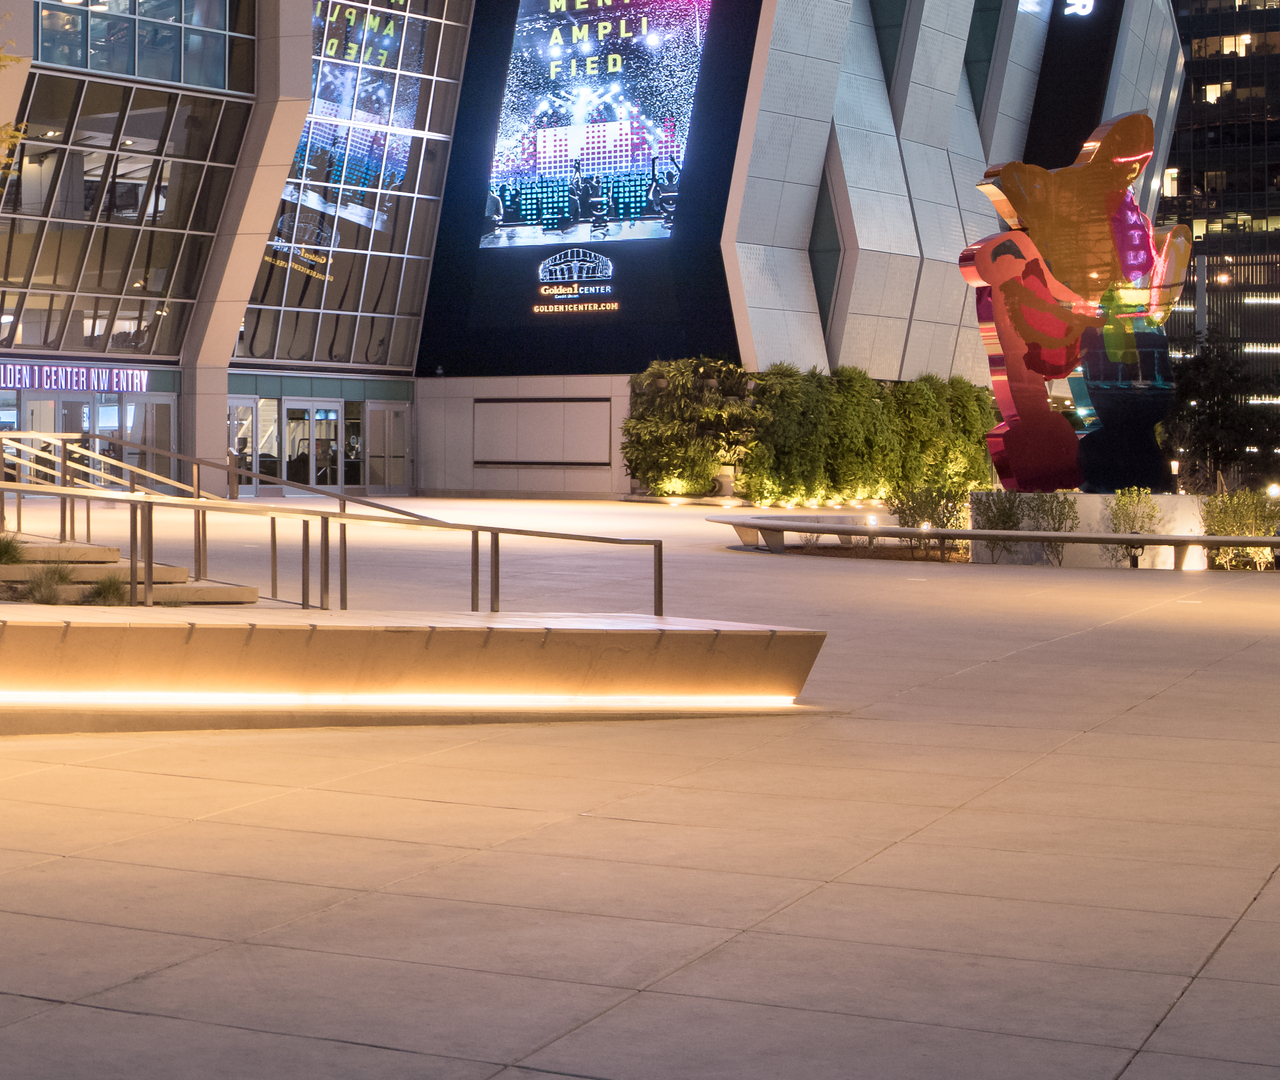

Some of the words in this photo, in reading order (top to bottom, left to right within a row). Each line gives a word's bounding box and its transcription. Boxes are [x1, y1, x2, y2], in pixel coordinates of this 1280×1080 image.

[549, 16, 648, 46] AMPLI
[550, 53, 623, 80] FIED
[579, 285, 612, 294] CENTER
[533, 302, 619, 313] GOLDEN1CENTER.COM
[33, 366, 39, 389] 1
[42, 366, 87, 391] CENTER
[91, 368, 110, 392] NW
[113, 369, 149, 393] ENTRY
